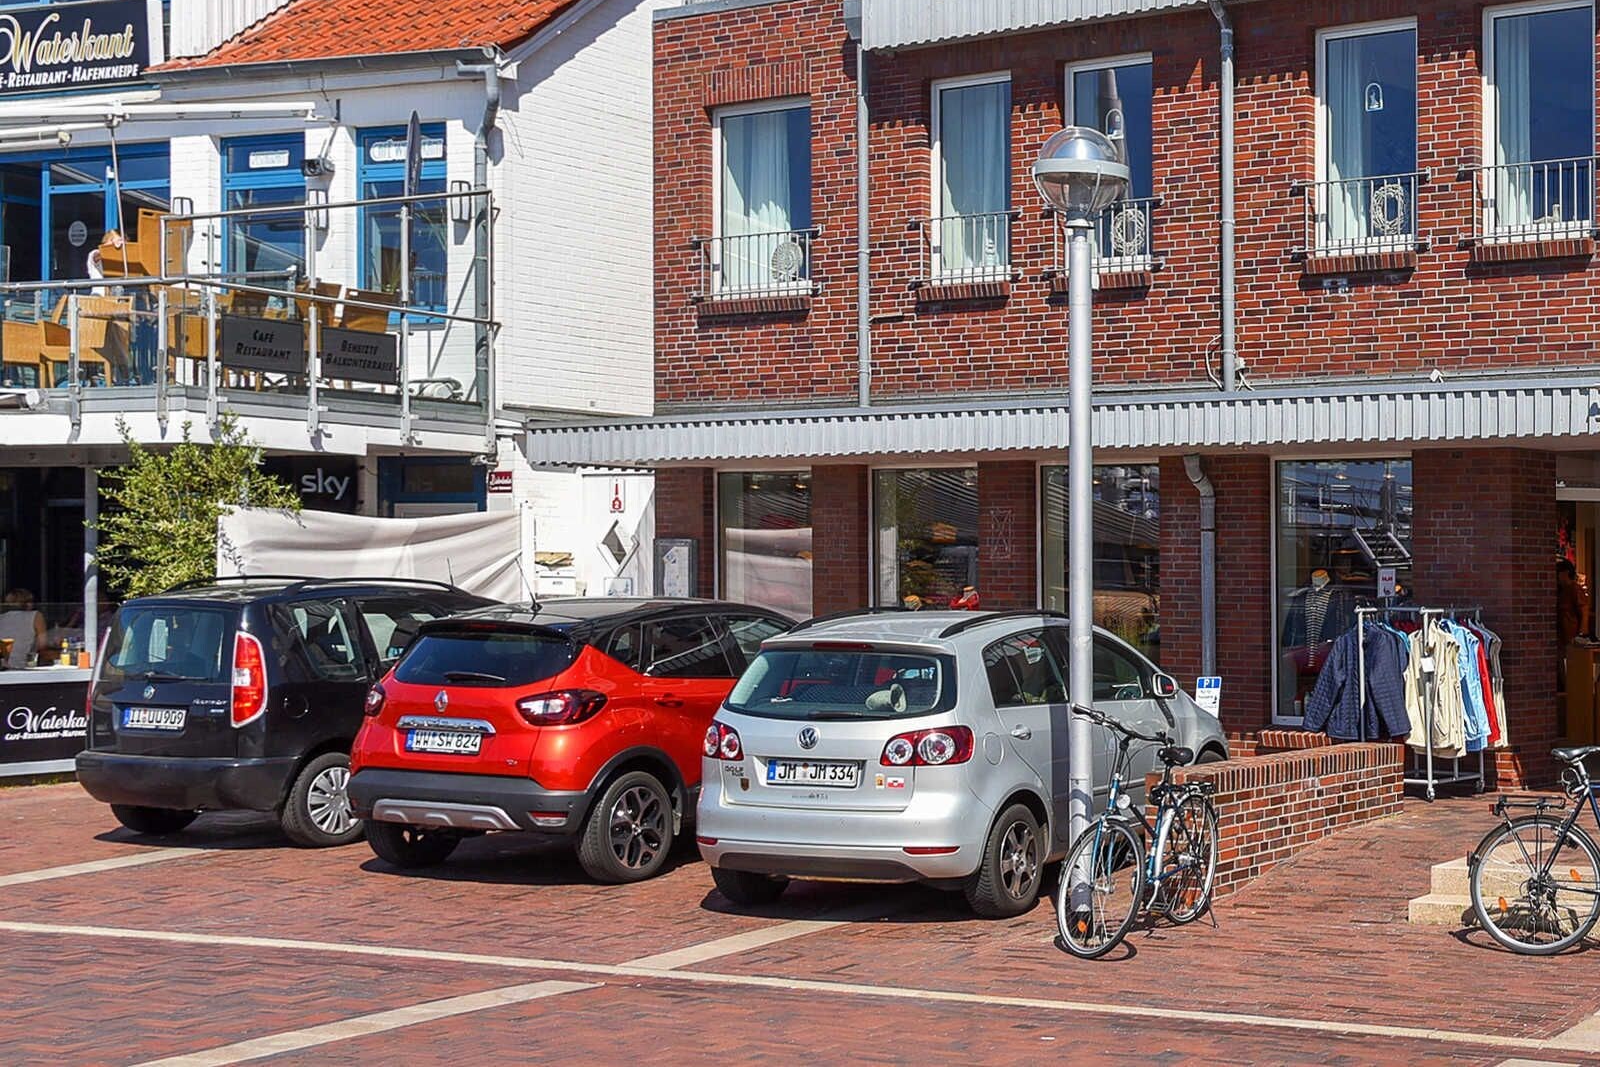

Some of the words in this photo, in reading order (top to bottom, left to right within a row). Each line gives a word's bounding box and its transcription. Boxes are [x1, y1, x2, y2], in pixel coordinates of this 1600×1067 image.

[0, 13, 135, 74] Waterkant
[301, 468, 350, 500] sky
[455, 734, 478, 749] 824
[778, 762, 797, 780] JM
[809, 764, 826, 780] JM
[829, 764, 854, 781] 334
